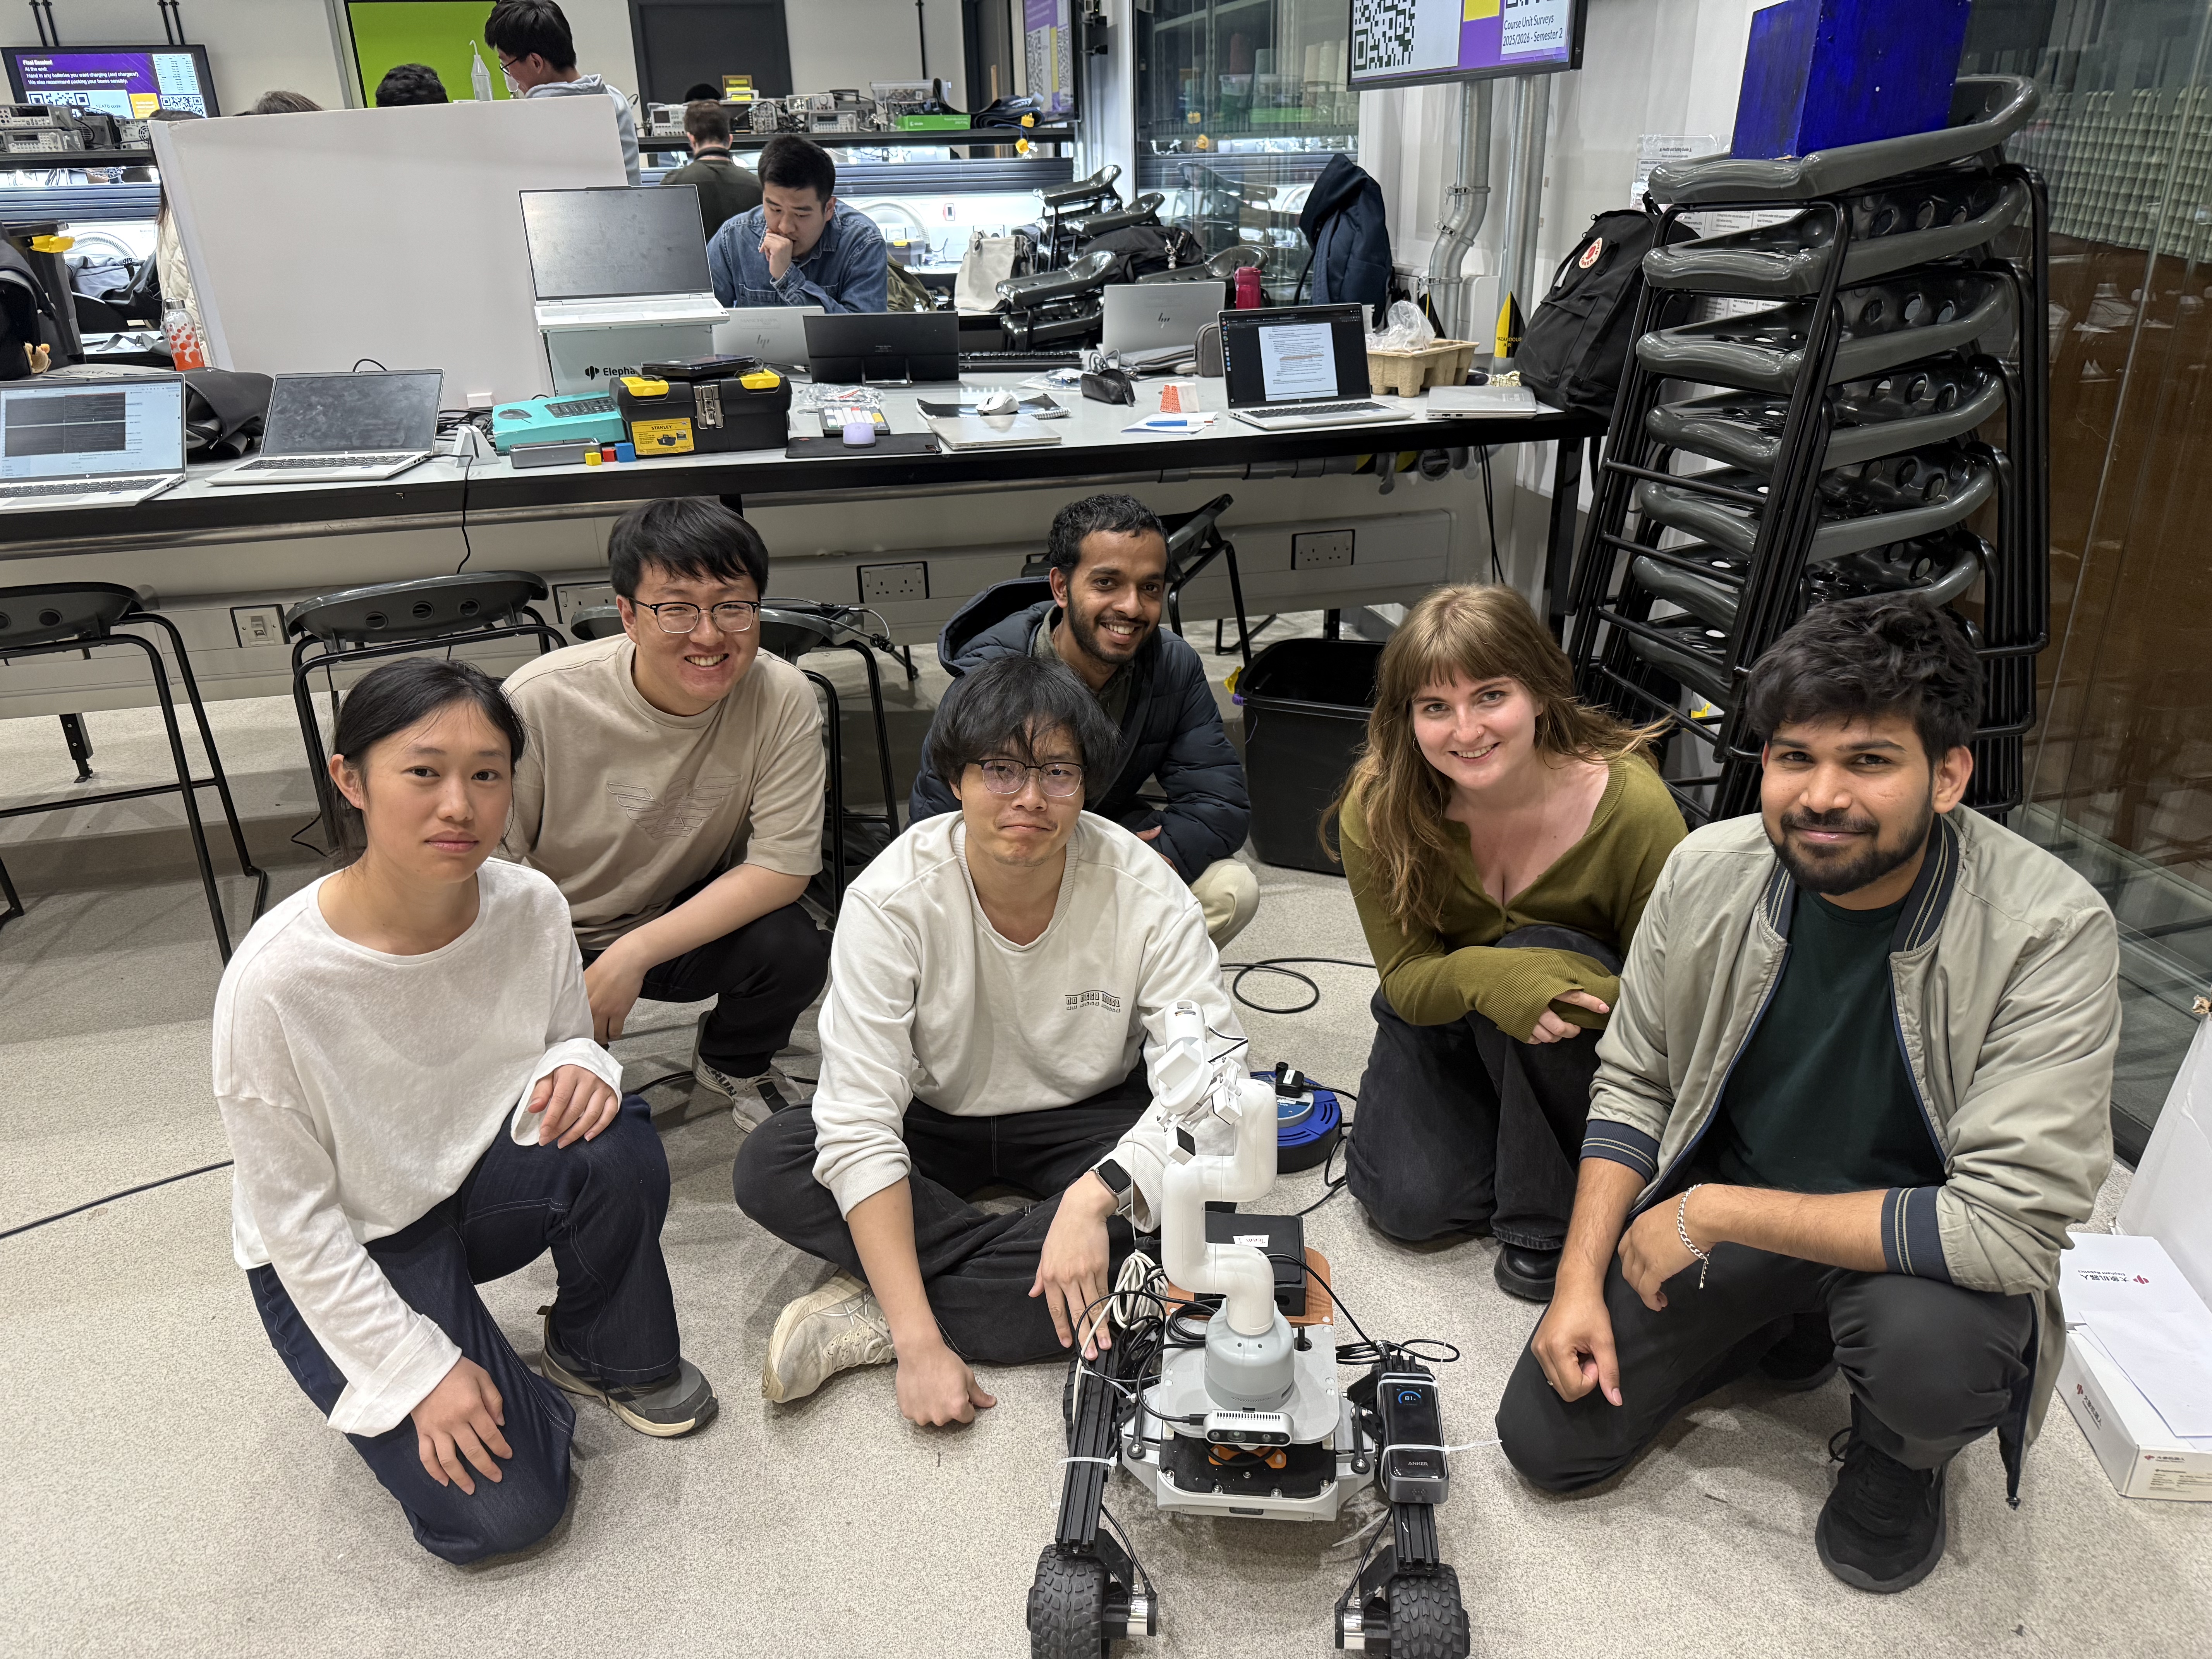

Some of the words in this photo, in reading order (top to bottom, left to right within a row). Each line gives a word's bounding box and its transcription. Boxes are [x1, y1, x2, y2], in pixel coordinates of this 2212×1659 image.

[1504, 20, 1521, 30] Course
[1522, 16, 1533, 27] Unit
[1534, 15, 1554, 26] Surveys
[1503, 32, 1530, 46] 2025/2026
[1534, 30, 1558, 42] Semester
[1559, 27, 1563, 39] 2
[2079, 1274, 2130, 1282] 大象机器人
